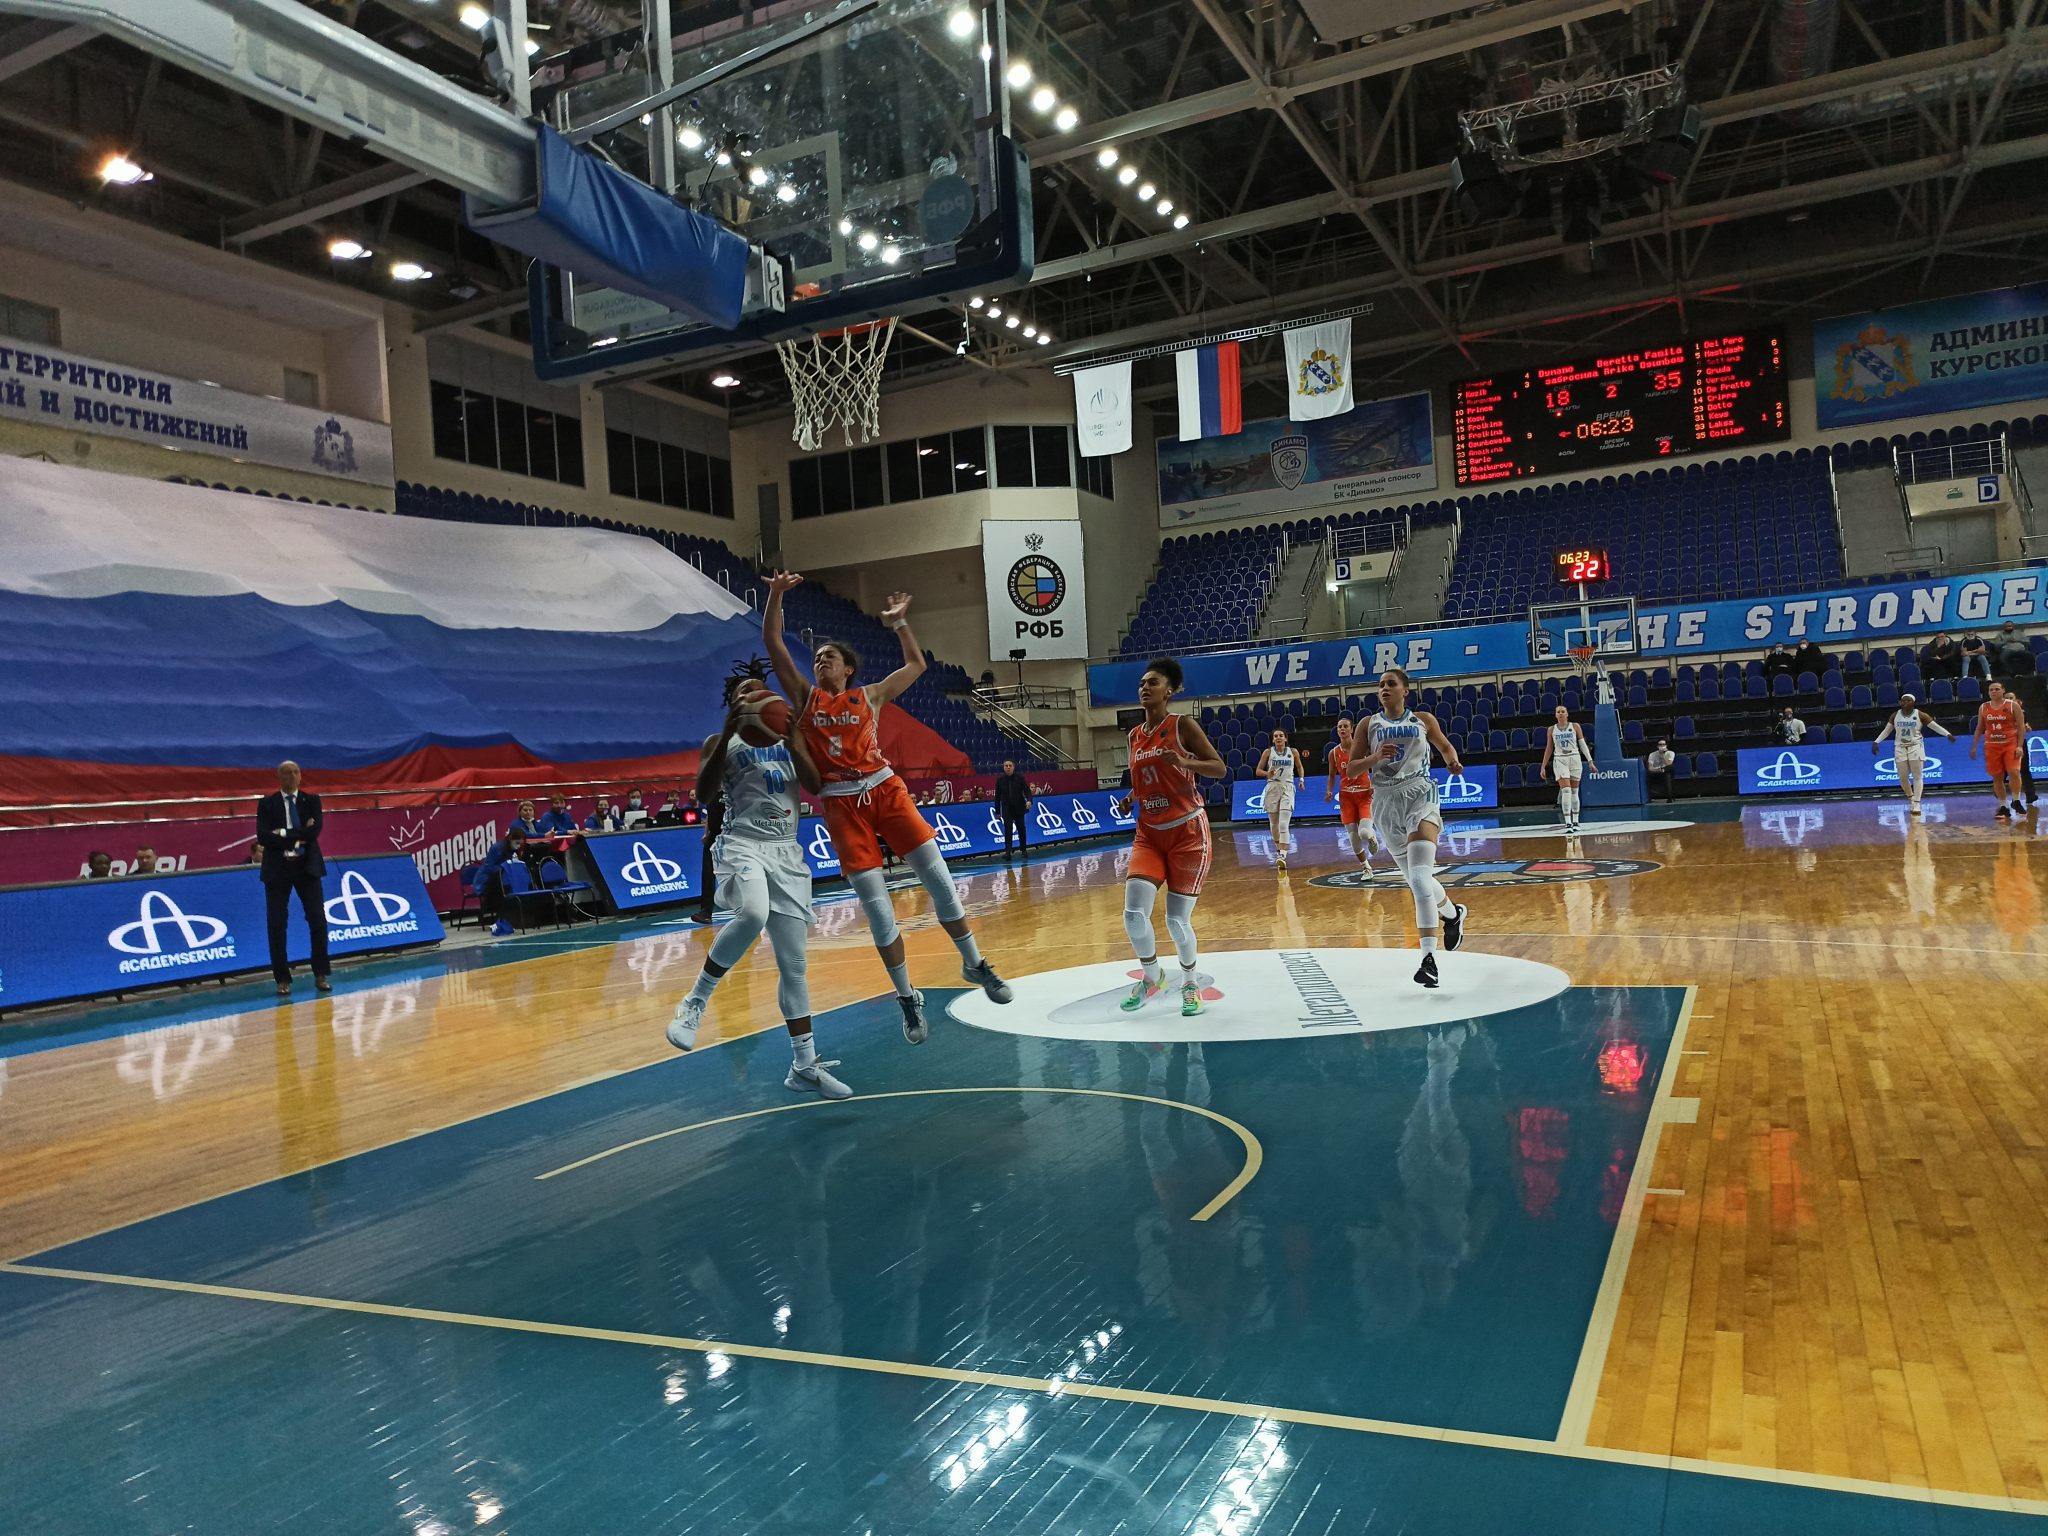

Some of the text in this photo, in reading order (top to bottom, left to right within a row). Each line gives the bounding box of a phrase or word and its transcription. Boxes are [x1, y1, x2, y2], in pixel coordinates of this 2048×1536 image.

[1596, 346, 1683, 368] Beretta Famila
[1538, 366, 1574, 379] Dynamo
[1654, 371, 1682, 390] 35
[1546, 390, 1570, 408] 18
[1606, 384, 1618, 398] 2
[1692, 388, 1702, 396] 10
[1694, 396, 1703, 404] 14
[1708, 402, 1732, 412] Dotto
[40, 390, 60, 414] И
[73, 396, 249, 450] ДОСТИЖЕНИЙ
[1596, 409, 1630, 421] ВРЕМЯ
[1694, 414, 1704, 422] 31
[1776, 402, 1782, 410] 2
[1526, 432, 1533, 440] 9
[1576, 416, 1634, 439] 06:23
[1696, 432, 1706, 440] 35
[1776, 420, 1782, 428] 7
[1658, 440, 1672, 454] 2
[1334, 472, 1421, 490] Генеральный спонсор
[1334, 487, 1384, 500] БК «Динамо»
[1980, 483, 1997, 500] D
[1018, 557, 1054, 569] ФЕДЕРАЦИЯ
[1337, 564, 1349, 579] D
[1573, 560, 1599, 580] 22
[1048, 570, 1063, 610] БАСКЕТБОЛА
[1015, 620, 1064, 639] РФБ
[1245, 649, 1309, 686] WE
[1338, 638, 1433, 677] ARE
[1597, 610, 1707, 651] THE
[1746, 577, 2048, 640] STRONGE
[1377, 726, 1420, 742] DYNAMO
[736, 745, 791, 769] DYNAM
[1134, 746, 1163, 763] famila
[763, 770, 785, 795] 10
[1142, 766, 1159, 785] 31
[1590, 770, 1628, 780] molten
[1143, 798, 1169, 810] Beretta
